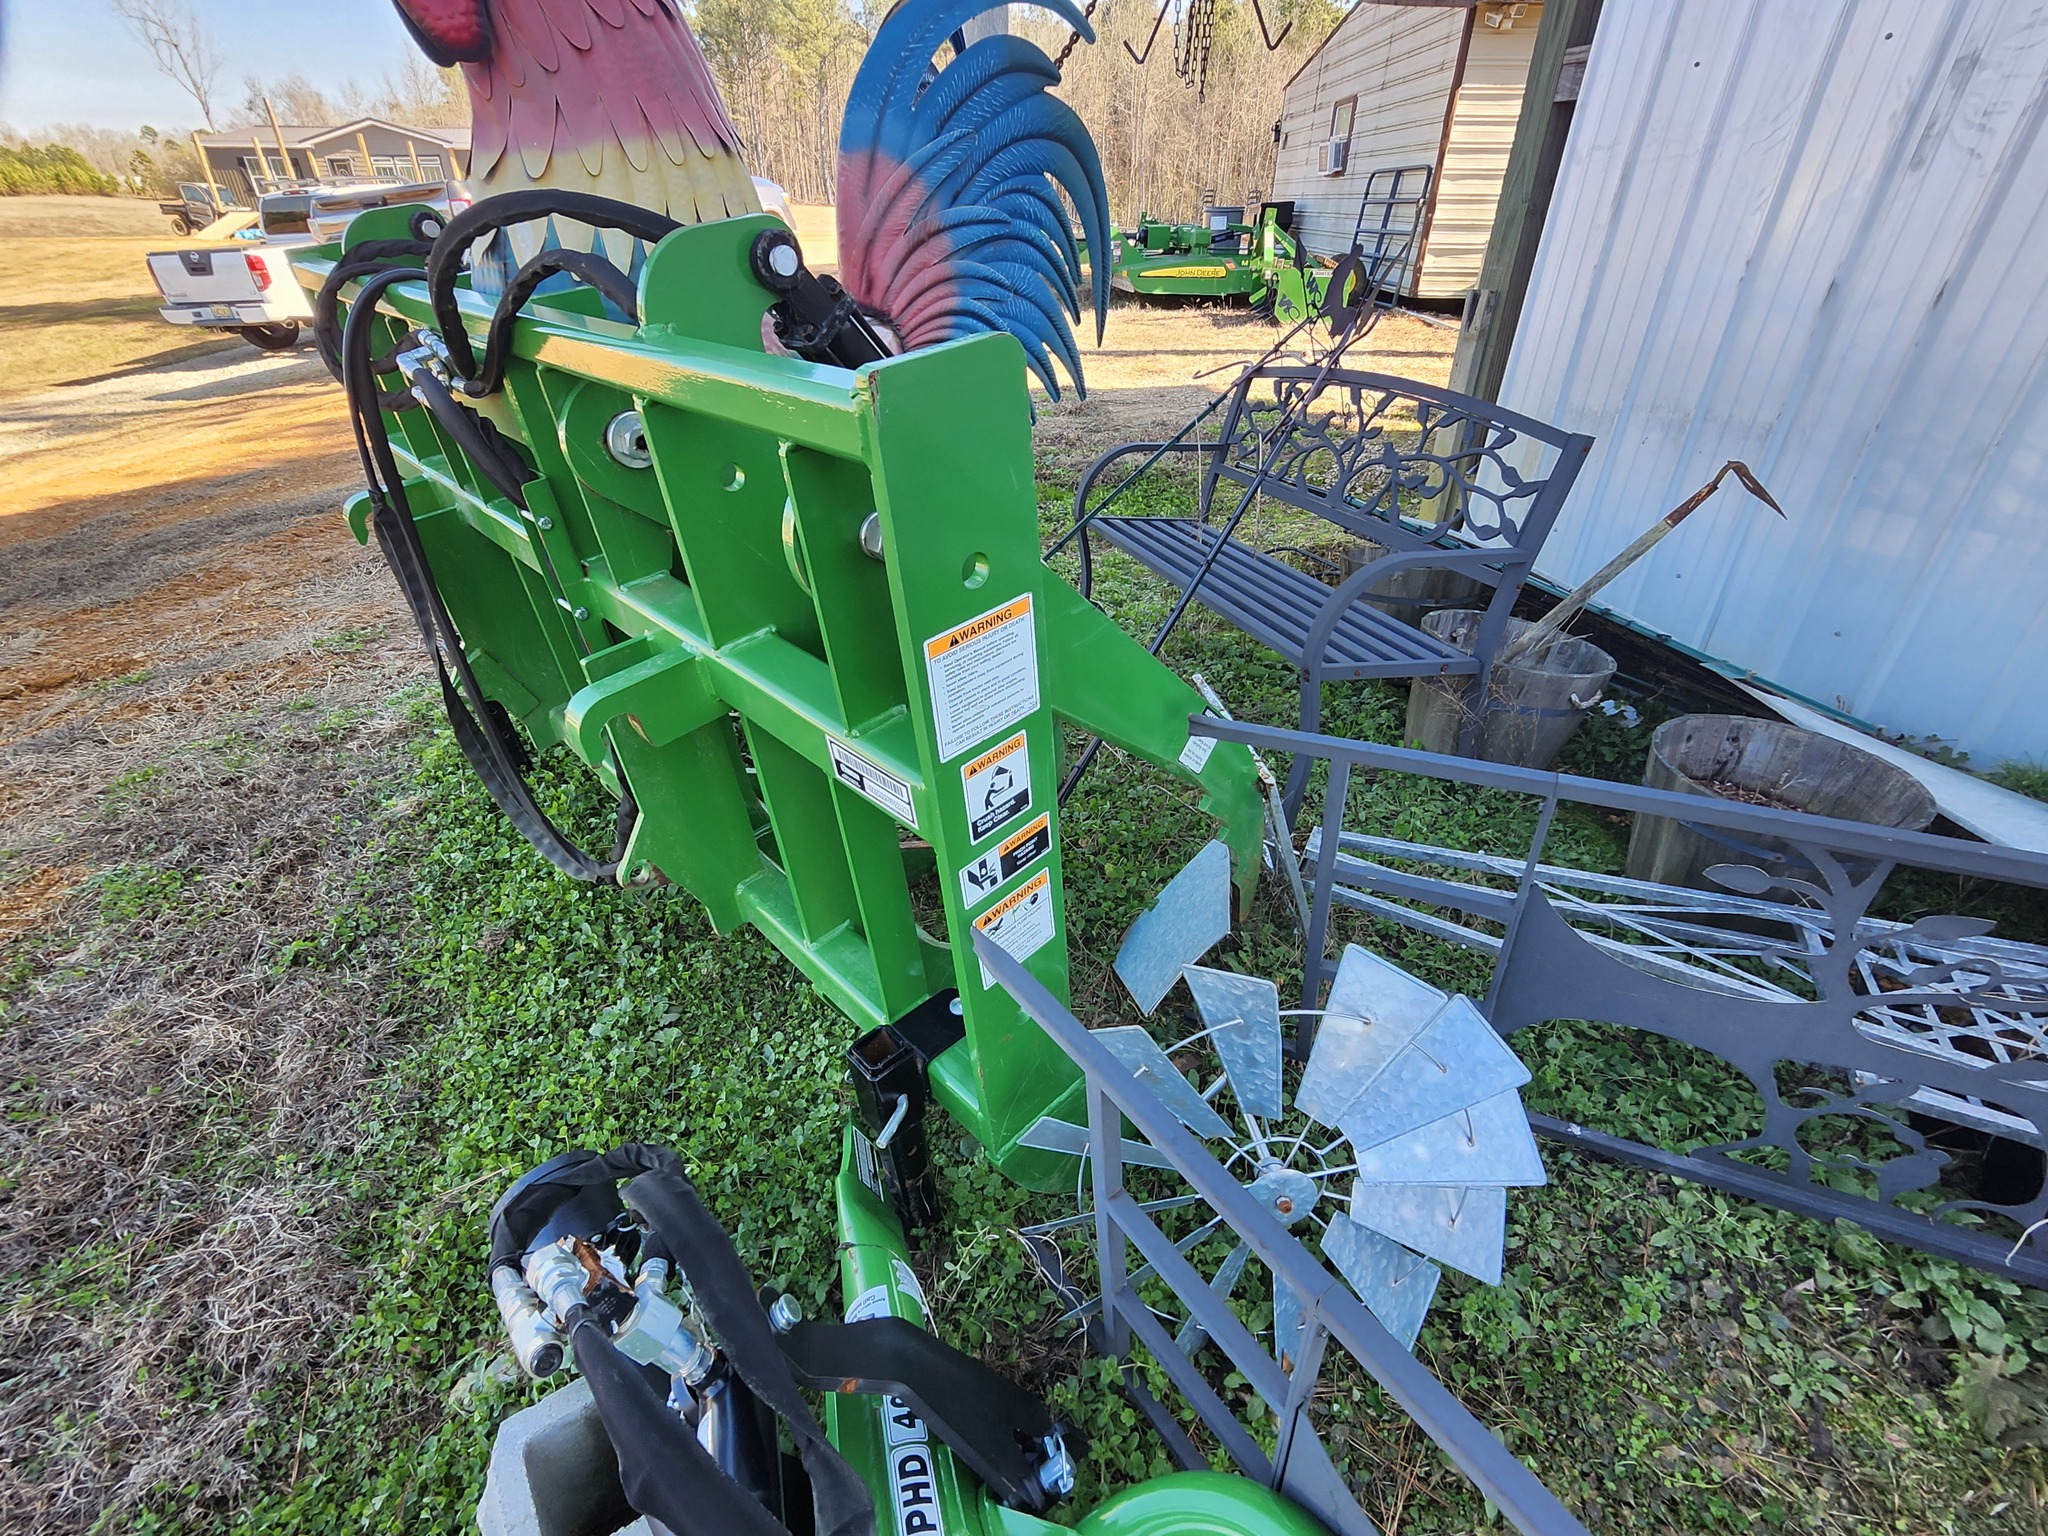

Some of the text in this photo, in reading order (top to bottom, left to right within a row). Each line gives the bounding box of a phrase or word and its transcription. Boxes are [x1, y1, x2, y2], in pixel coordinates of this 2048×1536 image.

[1176, 268, 1221, 277] JOHN DEERE
[959, 608, 1011, 642] WARNING
[933, 657, 941, 665] TO
[942, 649, 957, 661] AVOID
[958, 638, 981, 653] SERIOUS
[982, 628, 1000, 641] INJURY
[977, 738, 1020, 770] WARNING
[1009, 820, 1042, 847] WARNING
[991, 875, 1041, 920] WARNING
[897, 1454, 938, 1536] PHD
